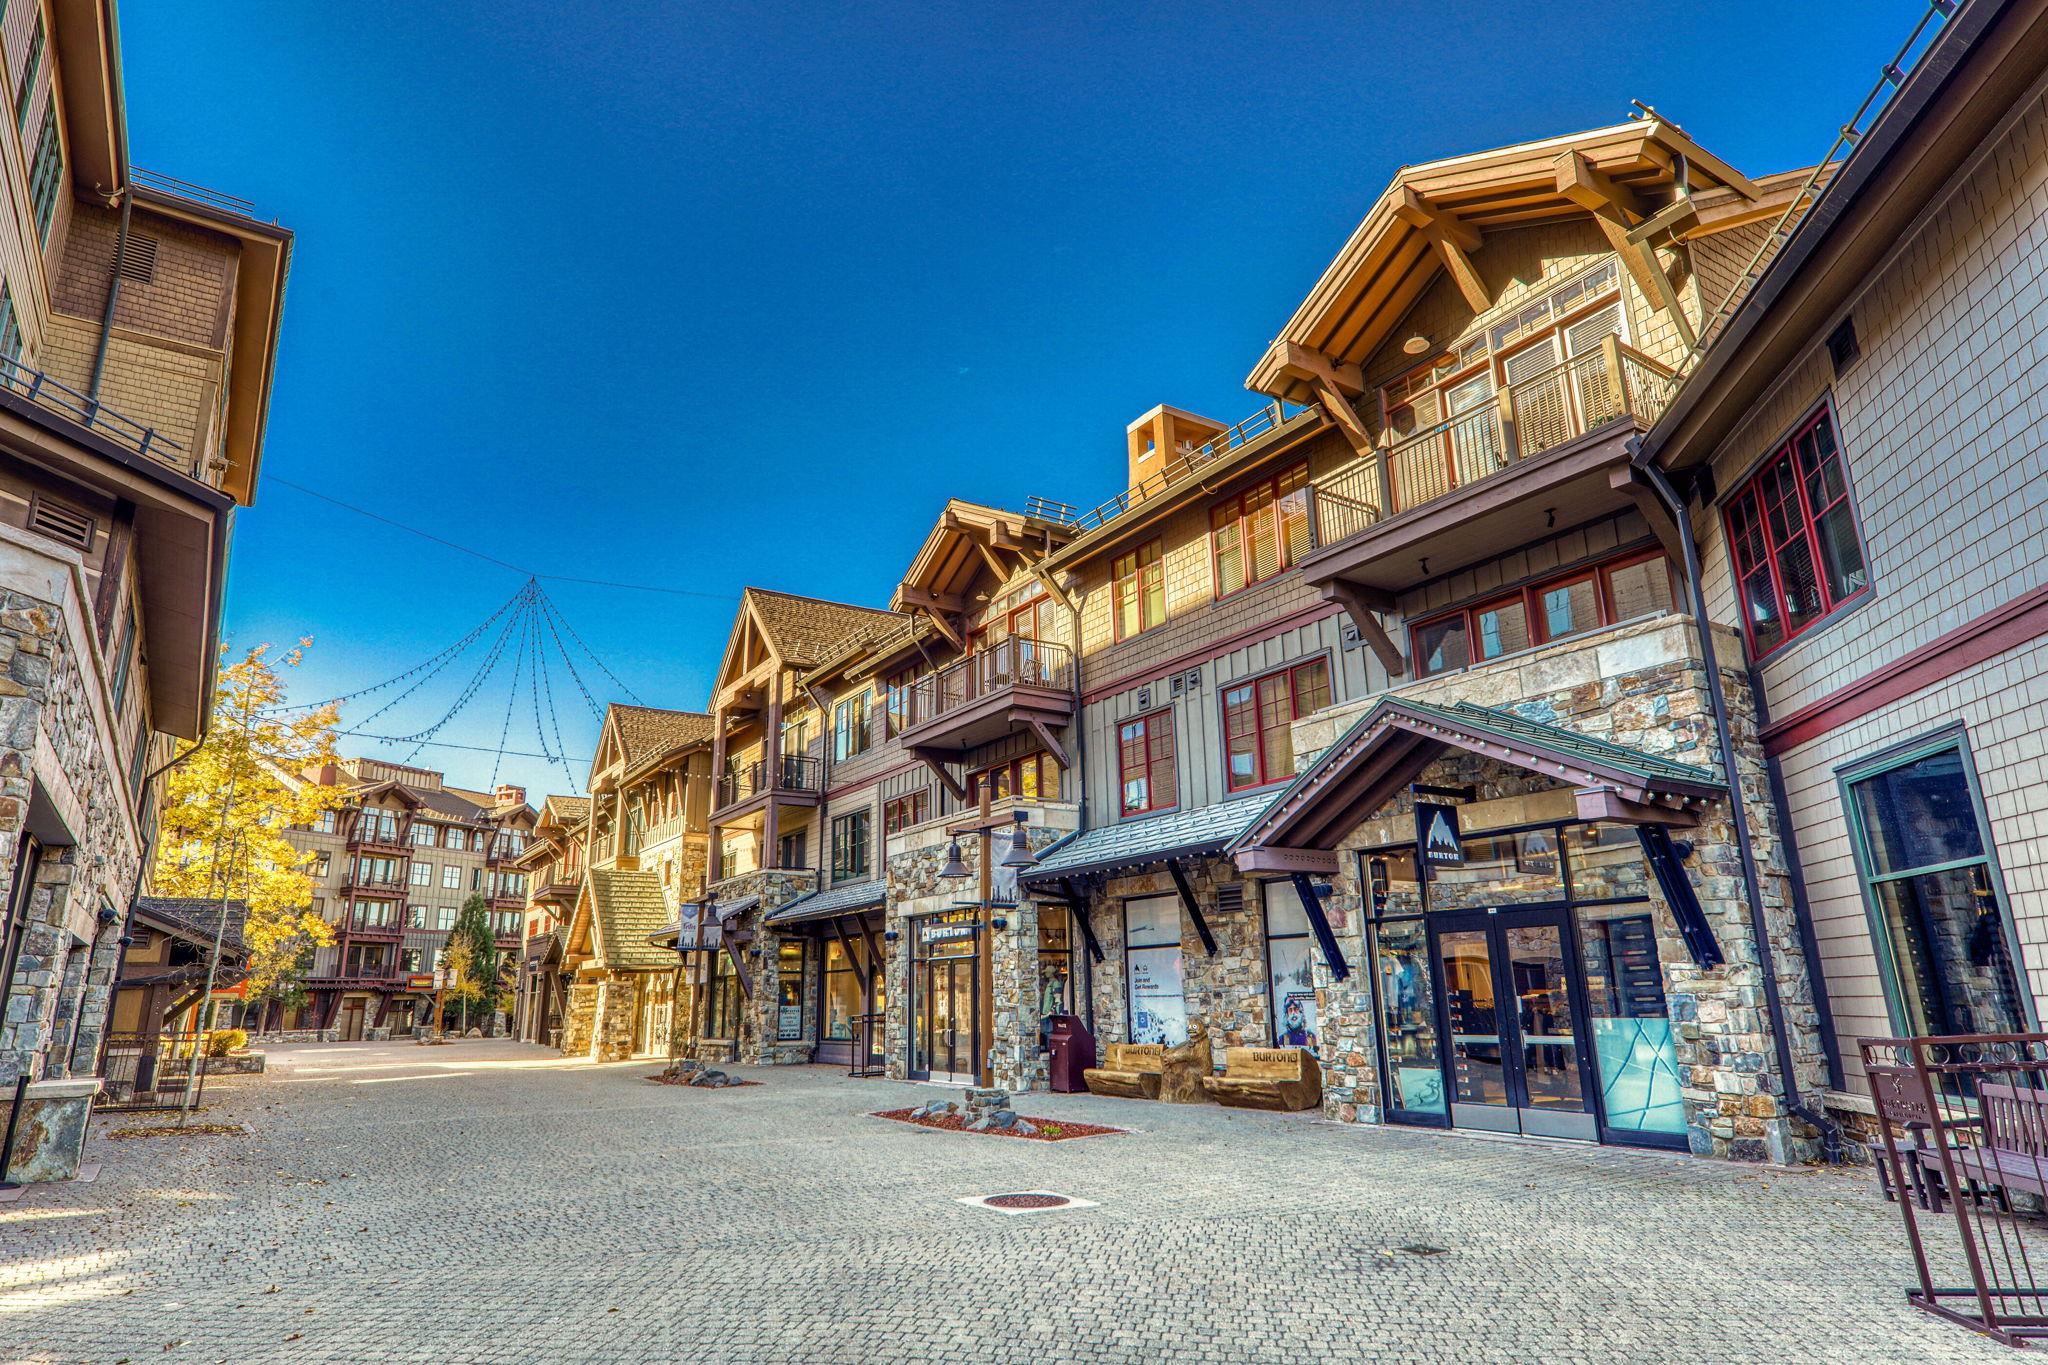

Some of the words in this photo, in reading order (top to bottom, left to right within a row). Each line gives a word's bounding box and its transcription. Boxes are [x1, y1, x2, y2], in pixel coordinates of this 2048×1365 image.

[1427, 851, 1460, 861] BURTON
[930, 926, 972, 939] BURTON
[1125, 1046, 1154, 1056] BURTON
[1252, 1052, 1290, 1063] BURTON
